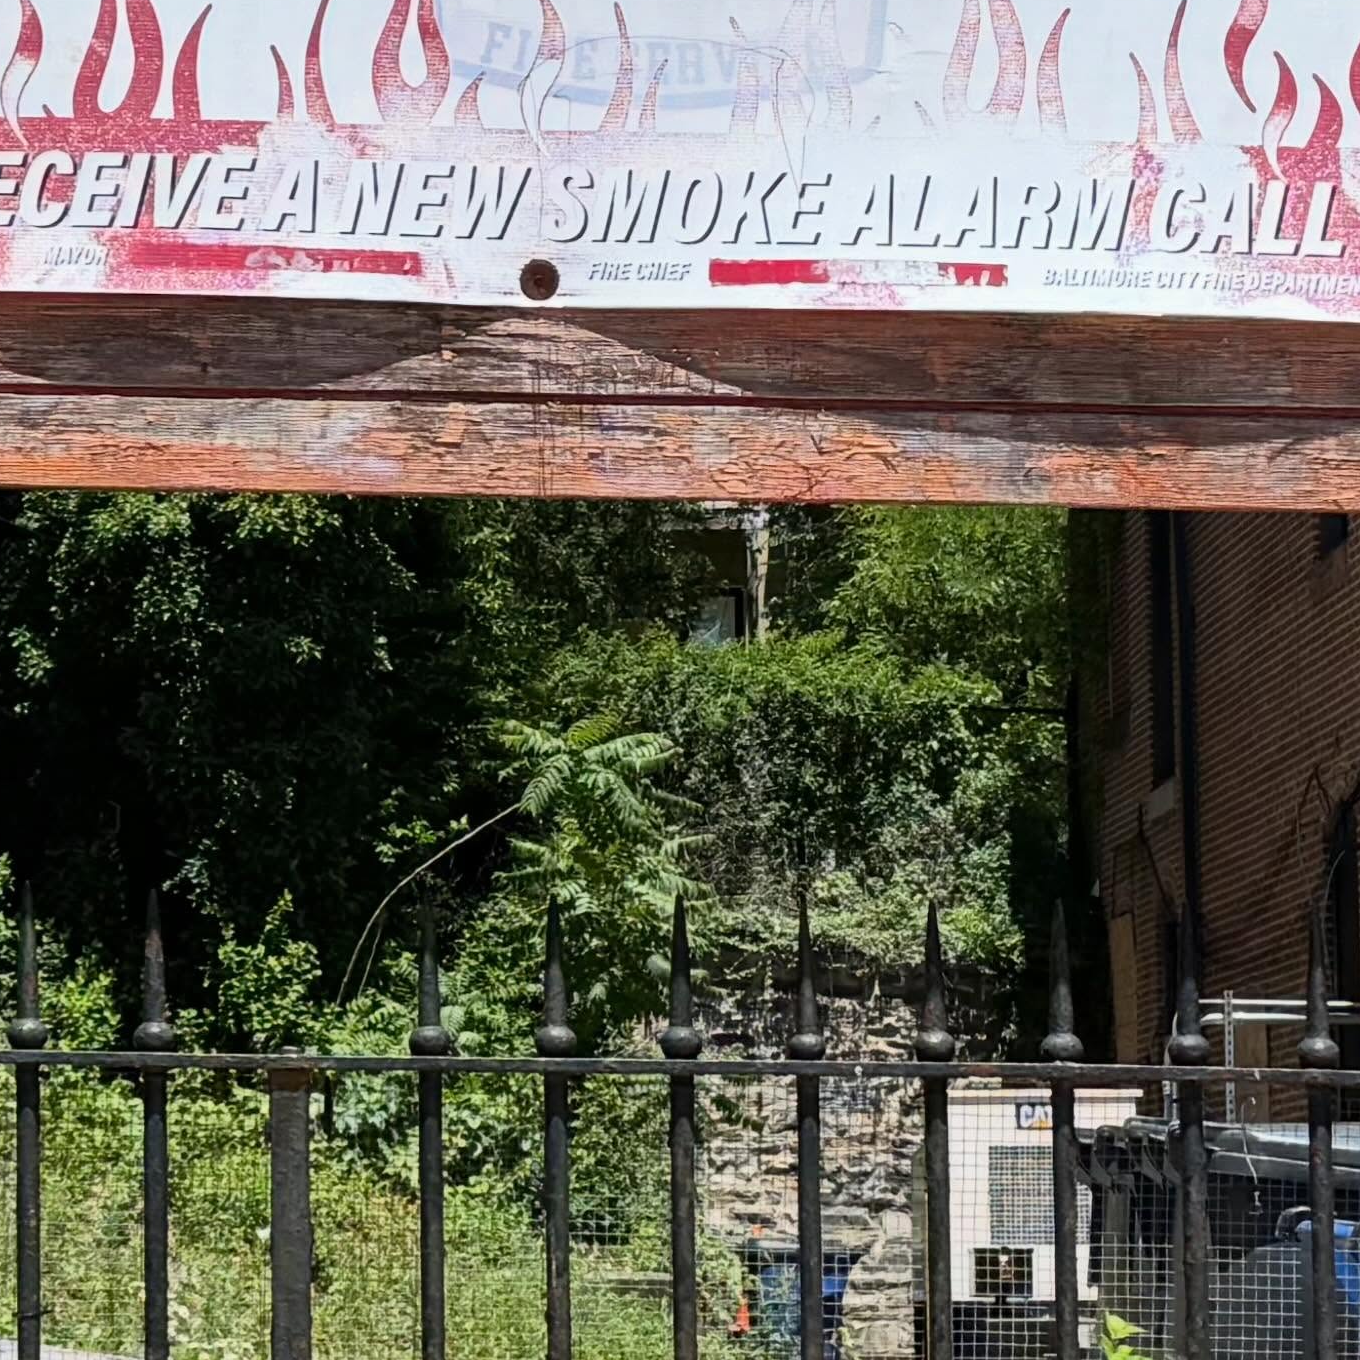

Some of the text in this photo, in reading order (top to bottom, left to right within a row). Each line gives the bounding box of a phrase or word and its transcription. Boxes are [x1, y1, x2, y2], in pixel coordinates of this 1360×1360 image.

[259, 157, 319, 234] A
[335, 160, 533, 241] NEW
[542, 166, 833, 246] SMOKE
[837, 172, 1136, 252] ALARM
[1150, 179, 1347, 259] CALL
[587, 261, 693, 282] FIRE CHIEF
[1042, 267, 1155, 289] BALTIMORE
[1155, 271, 1201, 290] CITY
[1202, 271, 1246, 291] FIRE
